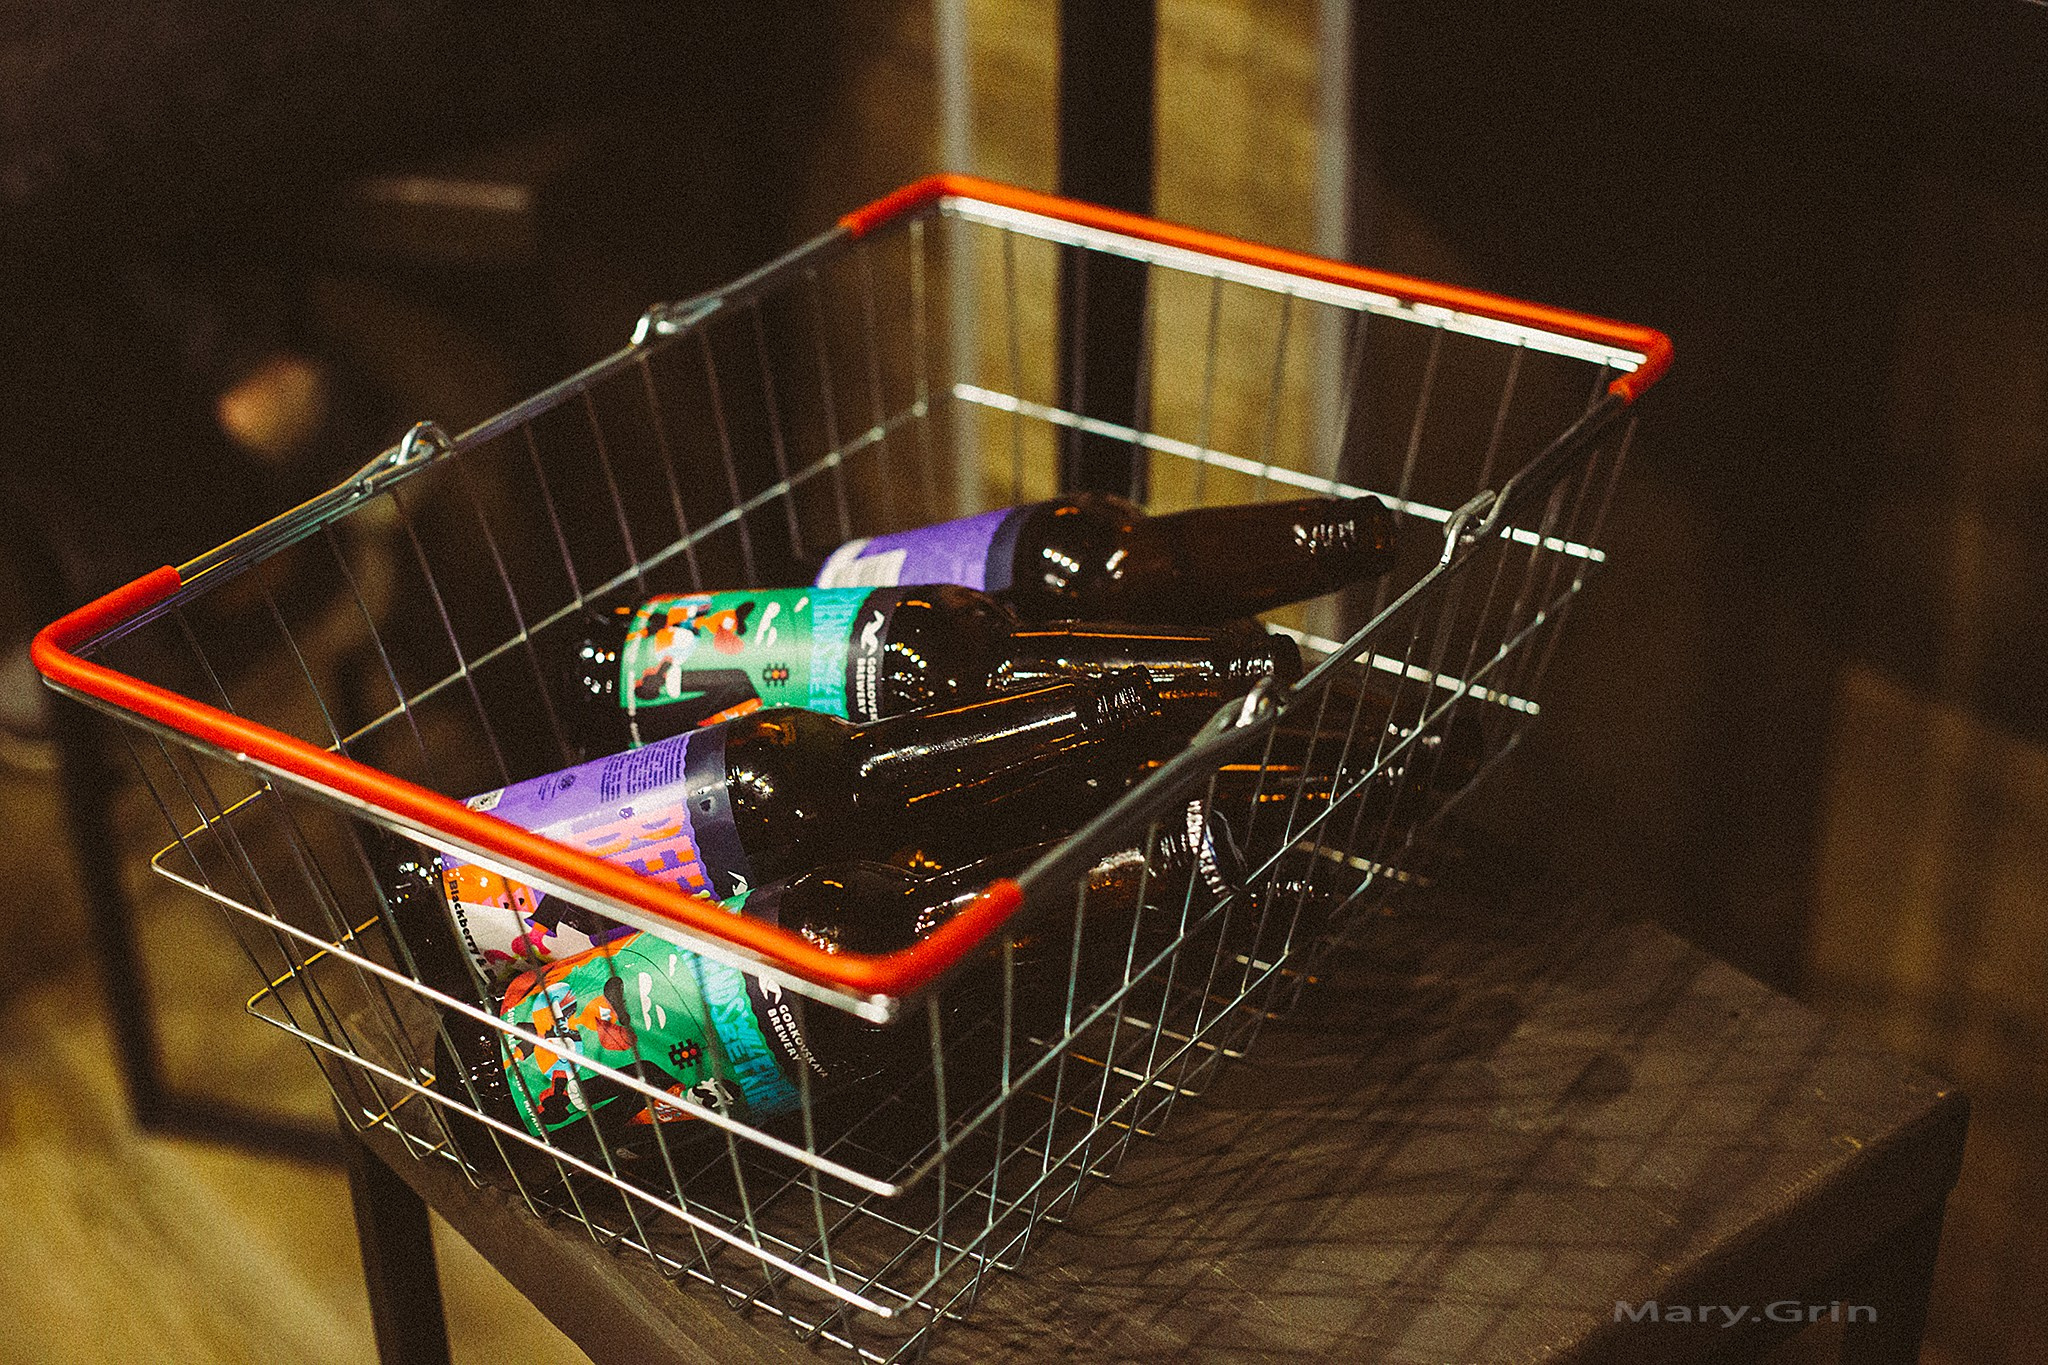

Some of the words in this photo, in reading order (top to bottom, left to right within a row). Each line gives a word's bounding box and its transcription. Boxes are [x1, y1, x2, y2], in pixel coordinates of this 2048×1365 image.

[448, 879, 481, 955] Blackberry
[715, 1021, 747, 1063] BE
[766, 1007, 802, 1062] BREWERY
[778, 1003, 829, 1079] GORKOVSKAYA
